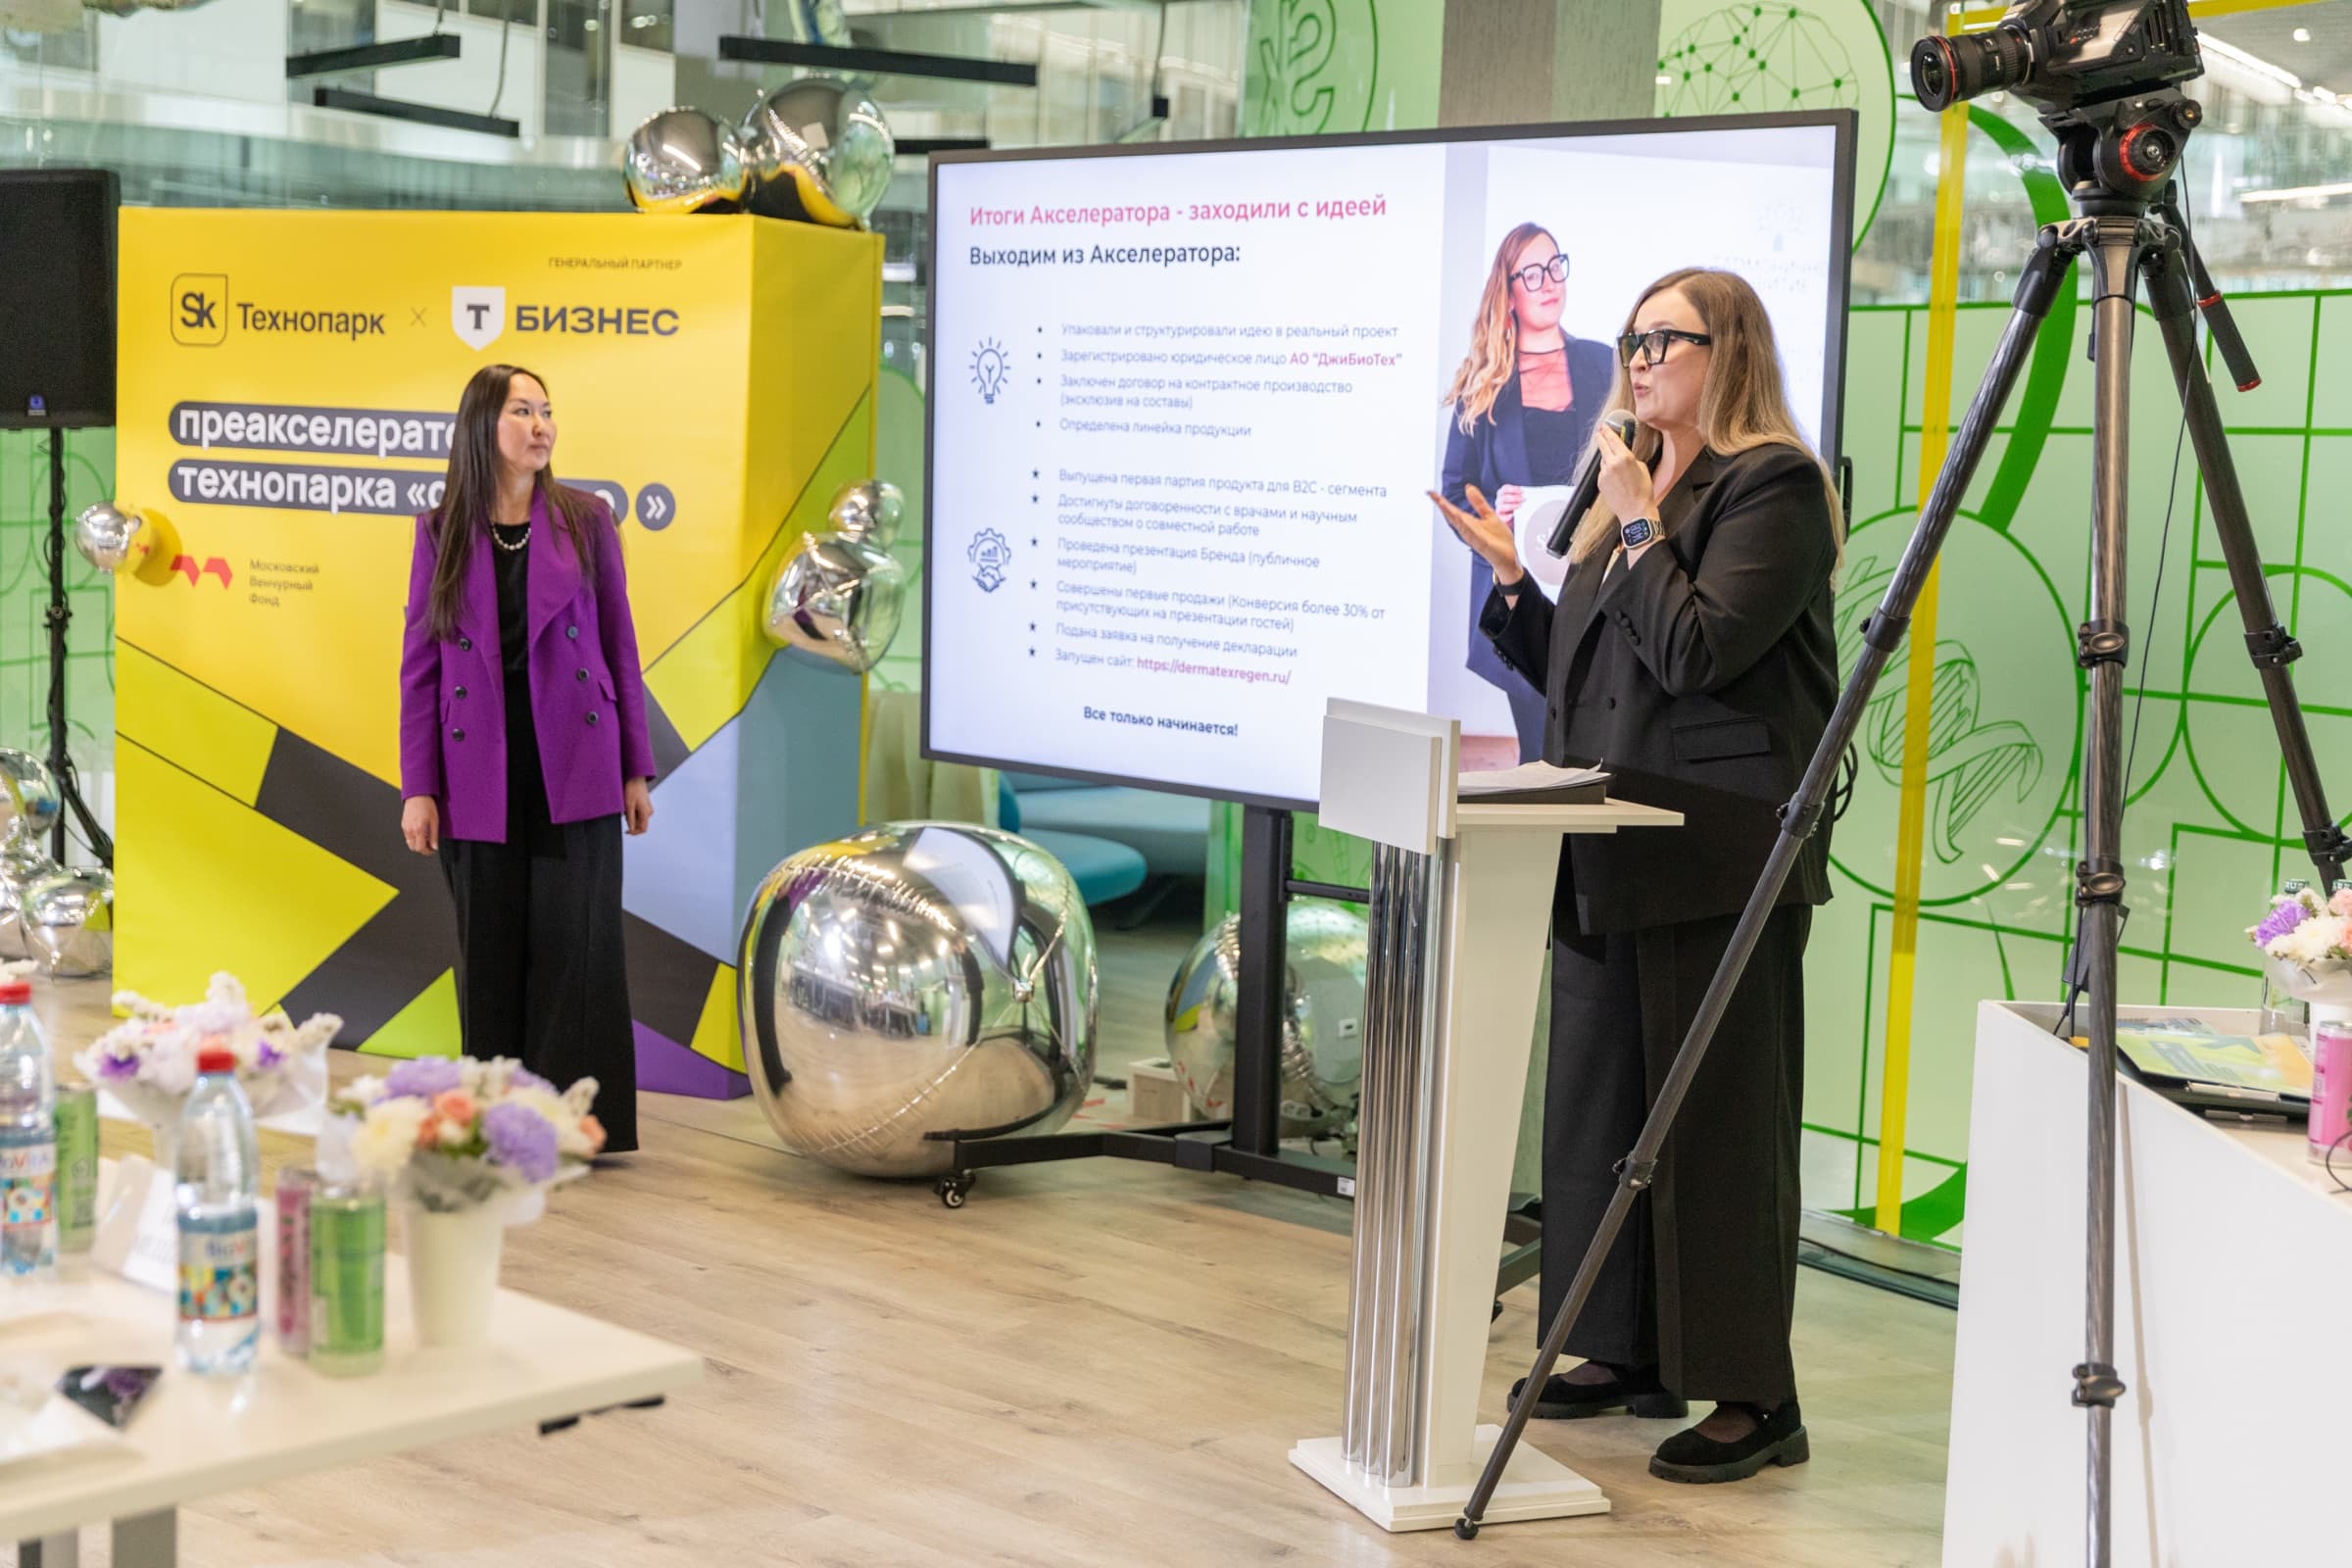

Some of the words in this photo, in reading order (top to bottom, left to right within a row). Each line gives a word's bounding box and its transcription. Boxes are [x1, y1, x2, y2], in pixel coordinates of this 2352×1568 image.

[970, 206, 1024, 227] Итоги
[1030, 204, 1170, 227] Акселератора
[1189, 201, 1291, 222] заходили
[1298, 202, 1309, 217] с
[1316, 194, 1387, 220] идеей
[548, 256, 629, 270] ГЕНЕРАЛЬНЫЙ
[630, 258, 683, 270] ПАРТНЕР
[970, 246, 1055, 268] Выходим
[1062, 249, 1084, 265] из
[1090, 243, 1241, 267] Акселератора:
[180, 291, 217, 327] Sk
[236, 302, 386, 341] Технопарк
[515, 304, 680, 336] БИЗНЕС
[1061, 323, 1121, 337] Упаковали
[1135, 324, 1237, 339] структурировали
[1239, 325, 1272, 339] идею
[1286, 323, 1348, 339] реальный
[1352, 325, 1398, 339] проект
[1060, 350, 1168, 364] Зарегистрировано
[1171, 351, 1251, 366] юридическое
[1255, 353, 1286, 366] лицо
[1289, 352, 1309, 366] АО
[1060, 374, 1114, 388] Заключен
[1117, 376, 1165, 391] договор
[1168, 377, 1182, 390] на
[1185, 377, 1260, 392] контрактное
[1264, 379, 1352, 395] производство
[1126, 395, 1139, 407] на
[1059, 419, 1129, 433] Определена
[1132, 420, 1181, 434] линейка
[1185, 423, 1251, 437] продукции
[177, 466, 396, 514] технопарка
[1058, 468, 1117, 485] Выпущена
[1121, 472, 1160, 488] первая
[1164, 475, 1205, 491] партия
[1208, 477, 1264, 494] продукта
[1267, 479, 1289, 493] для
[1328, 483, 1387, 498] сегмента
[1057, 494, 1122, 512] Достигнуты
[1125, 498, 1221, 515] договоренности
[1234, 505, 1286, 519] врачами
[1301, 509, 1357, 523] научным
[1058, 512, 1133, 528] сообществом
[1146, 518, 1215, 533] совместной
[1218, 522, 1259, 537] работе
[1057, 537, 1119, 554] Проведена
[1122, 543, 1198, 560] презентация
[1200, 547, 1246, 563] Бренда
[250, 560, 319, 573] Московский
[250, 576, 313, 591] Венчурный
[250, 594, 280, 607] Фонд
[1056, 580, 1122, 598] Совершены
[1125, 586, 1169, 603] первые
[1172, 590, 1225, 607] продажи
[1301, 599, 1340, 613] более
[1343, 603, 1368, 617] 30%
[1056, 599, 1150, 618] присутствующих
[1152, 607, 1166, 619] на
[1170, 608, 1247, 626] презентации
[1055, 623, 1097, 639] Подана
[1100, 628, 1138, 642] заявка
[1141, 631, 1153, 643] на
[1156, 632, 1220, 651] получение
[1223, 638, 1298, 658] декларации
[1054, 649, 1103, 664] Запущен
[1083, 706, 1106, 721] Все
[1109, 711, 1152, 726] только
[1156, 714, 1239, 736] начинается!
